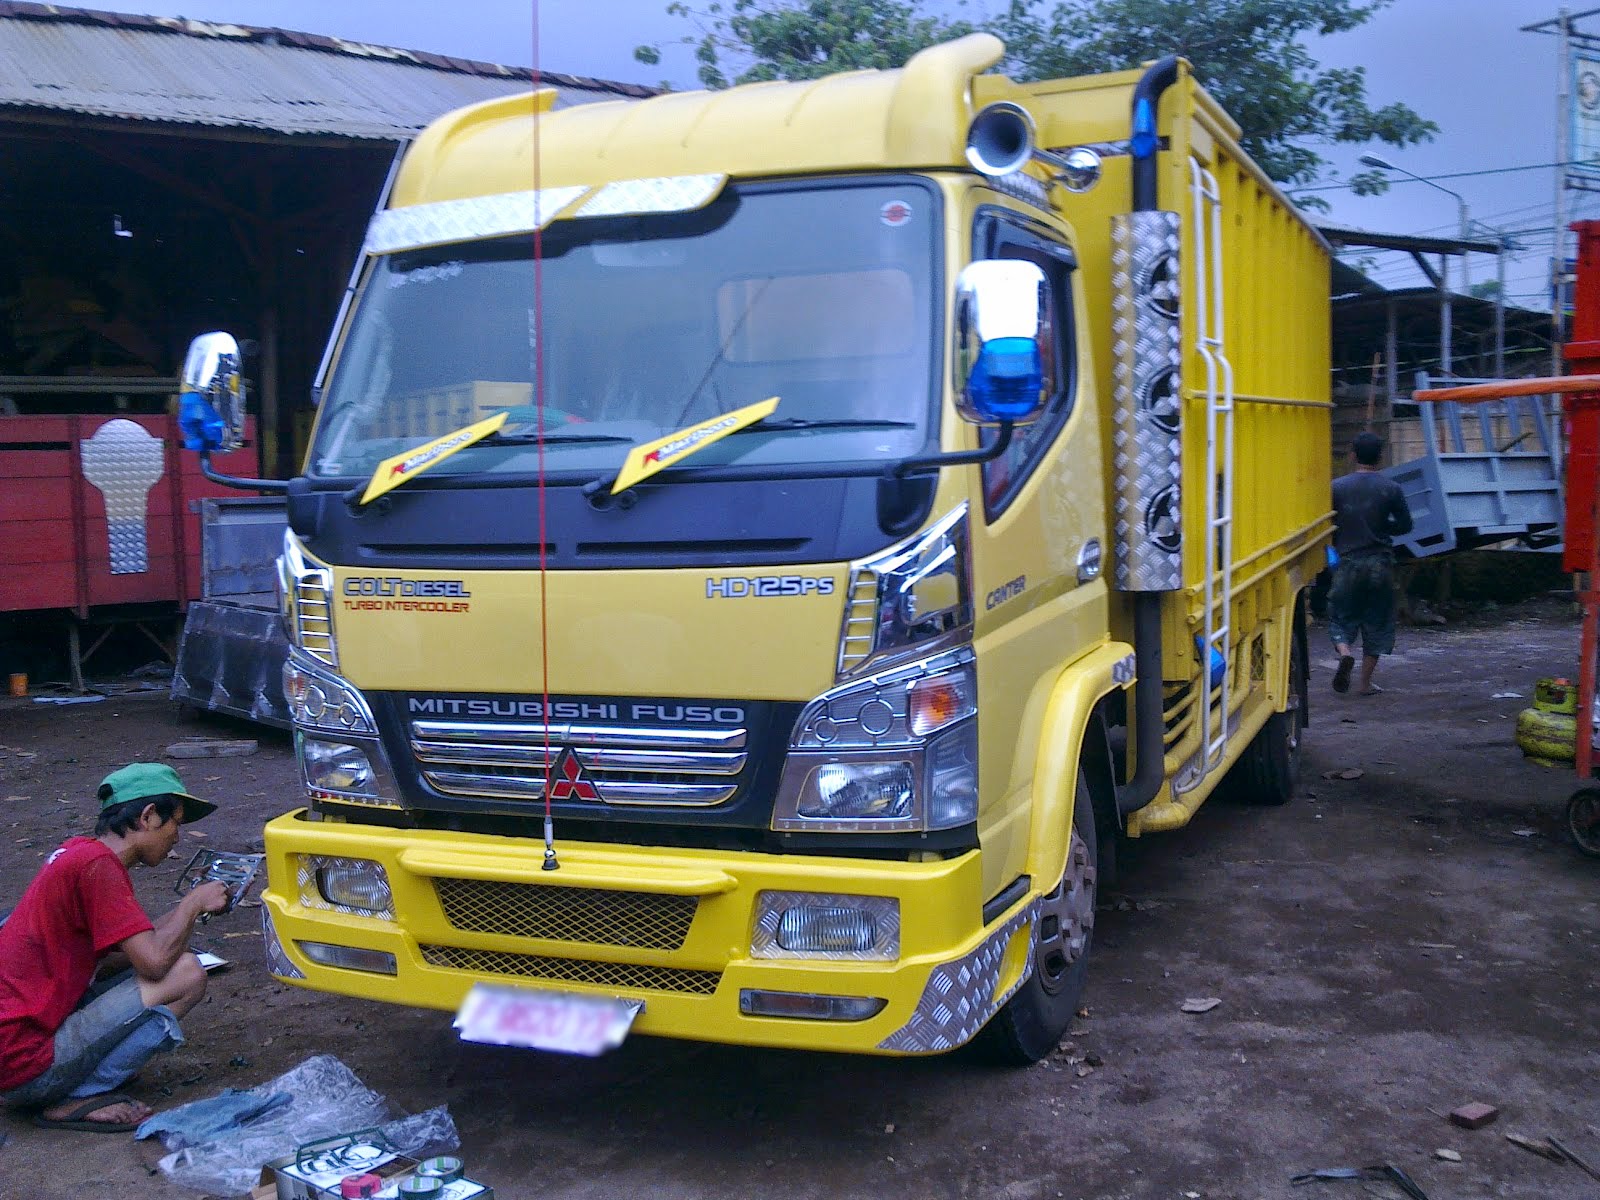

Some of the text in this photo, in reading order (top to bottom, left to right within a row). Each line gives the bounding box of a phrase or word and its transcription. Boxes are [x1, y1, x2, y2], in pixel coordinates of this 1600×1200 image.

[986, 575, 1026, 611] CANTER
[344, 600, 470, 613] TURBO INTERCOOLER
[409, 698, 745, 723] MITSUBISHI FUSO
